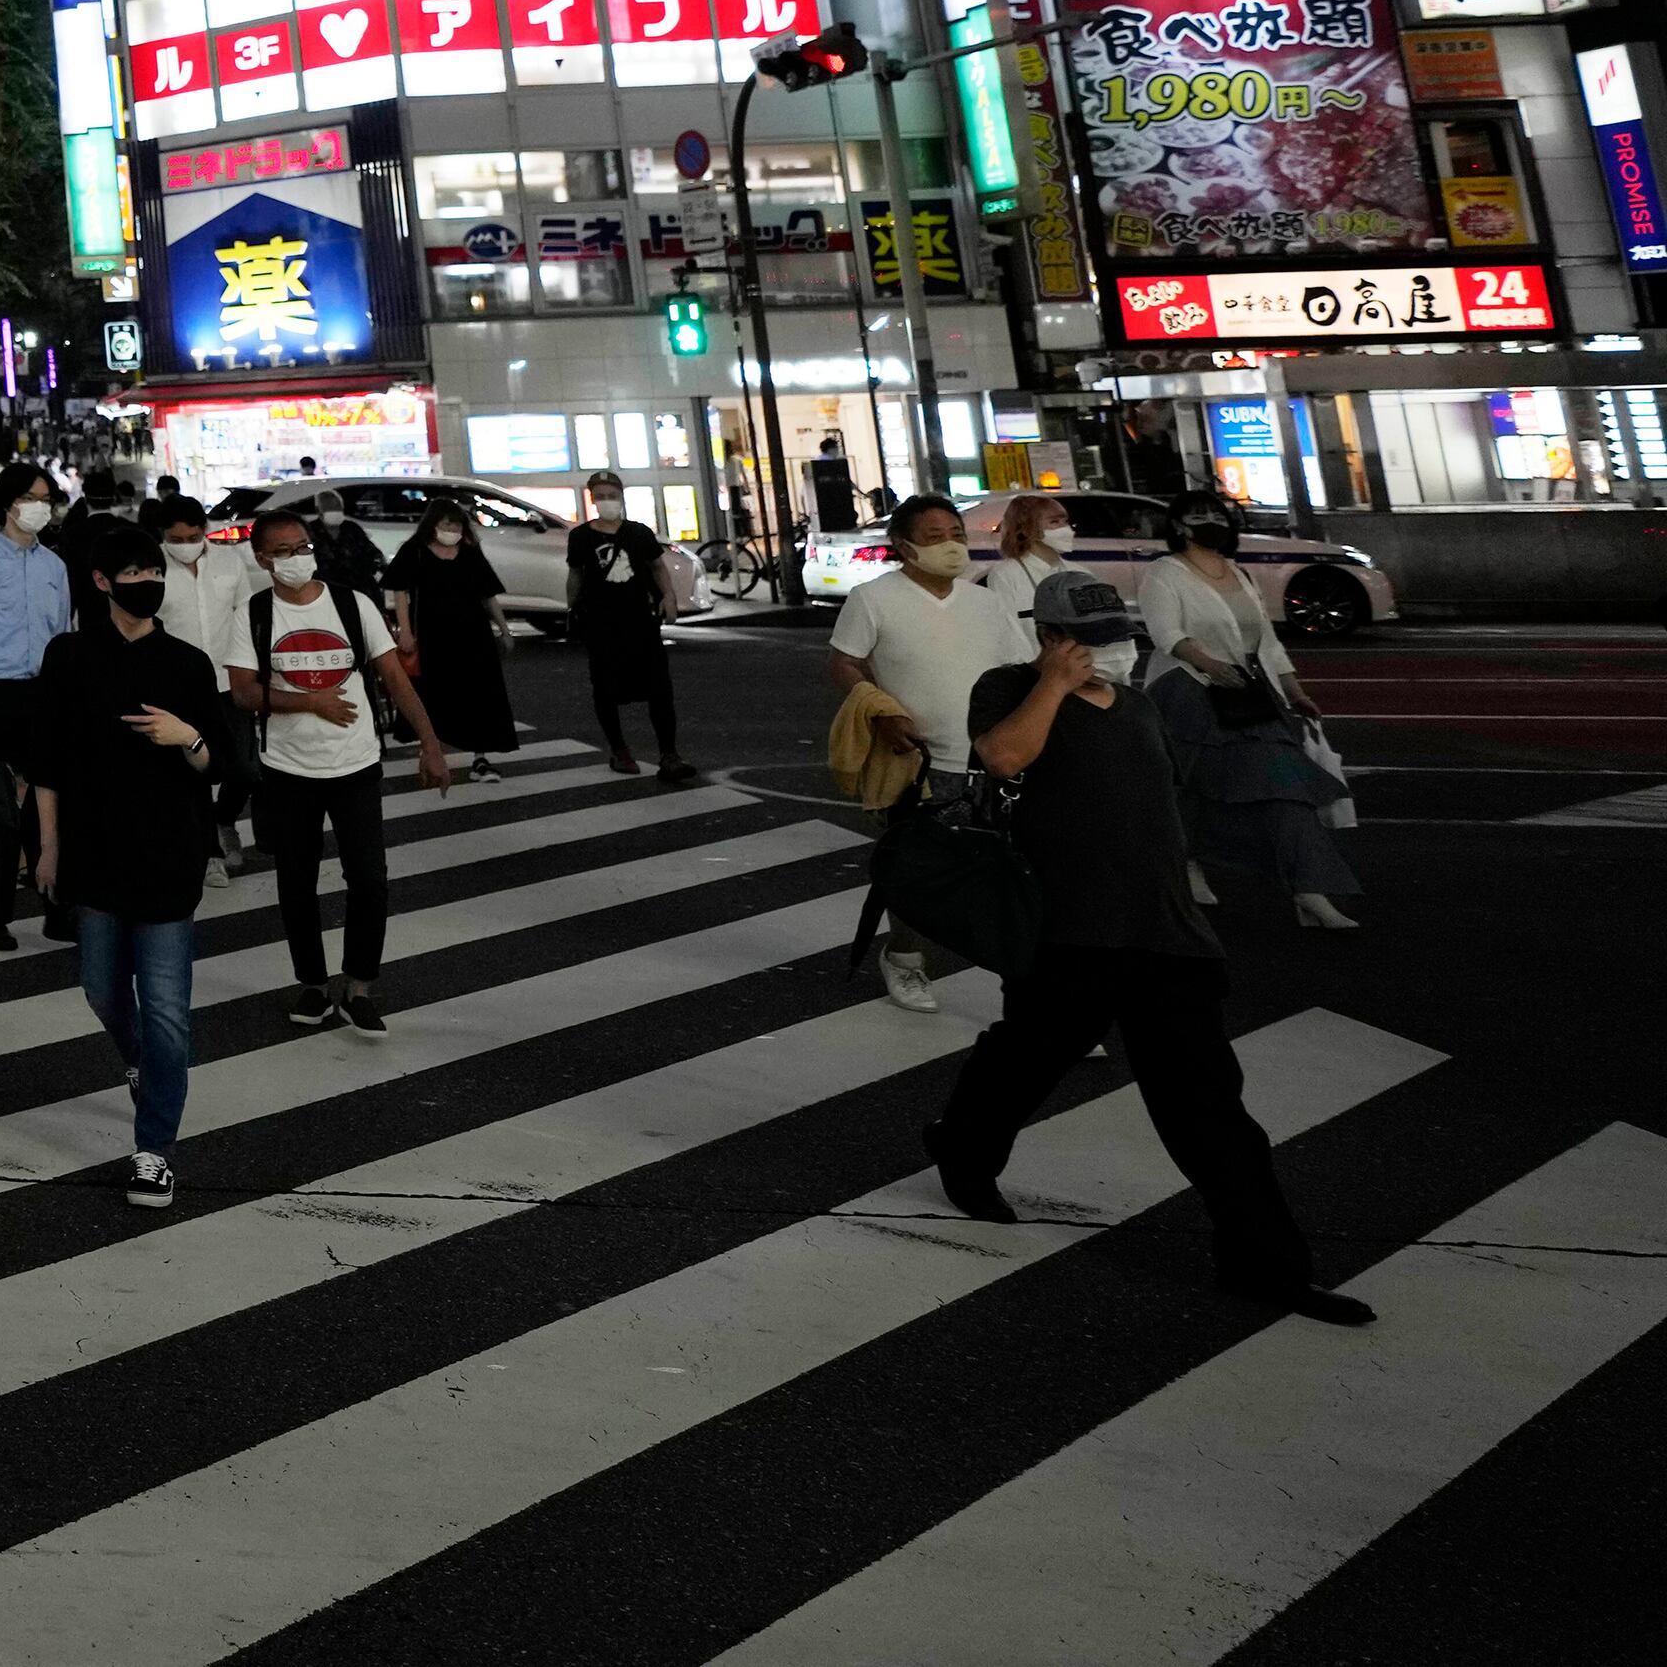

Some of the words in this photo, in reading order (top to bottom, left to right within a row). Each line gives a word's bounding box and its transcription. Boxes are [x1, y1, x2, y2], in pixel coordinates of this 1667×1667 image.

[234, 32, 280, 71] 3F
[165, 127, 348, 191] ミネドラッグ
[1613, 132, 1654, 235] PROMISE
[538, 208, 831, 257] ミネドッグ
[873, 211, 963, 284] 薬
[1155, 210, 1305, 245] 食べ放題
[214, 235, 319, 342] 薬
[1124, 280, 1185, 310] ちょい
[1300, 274, 1453, 327] 日高屋
[1469, 270, 1530, 307] 24
[1157, 302, 1208, 335] 飲み
